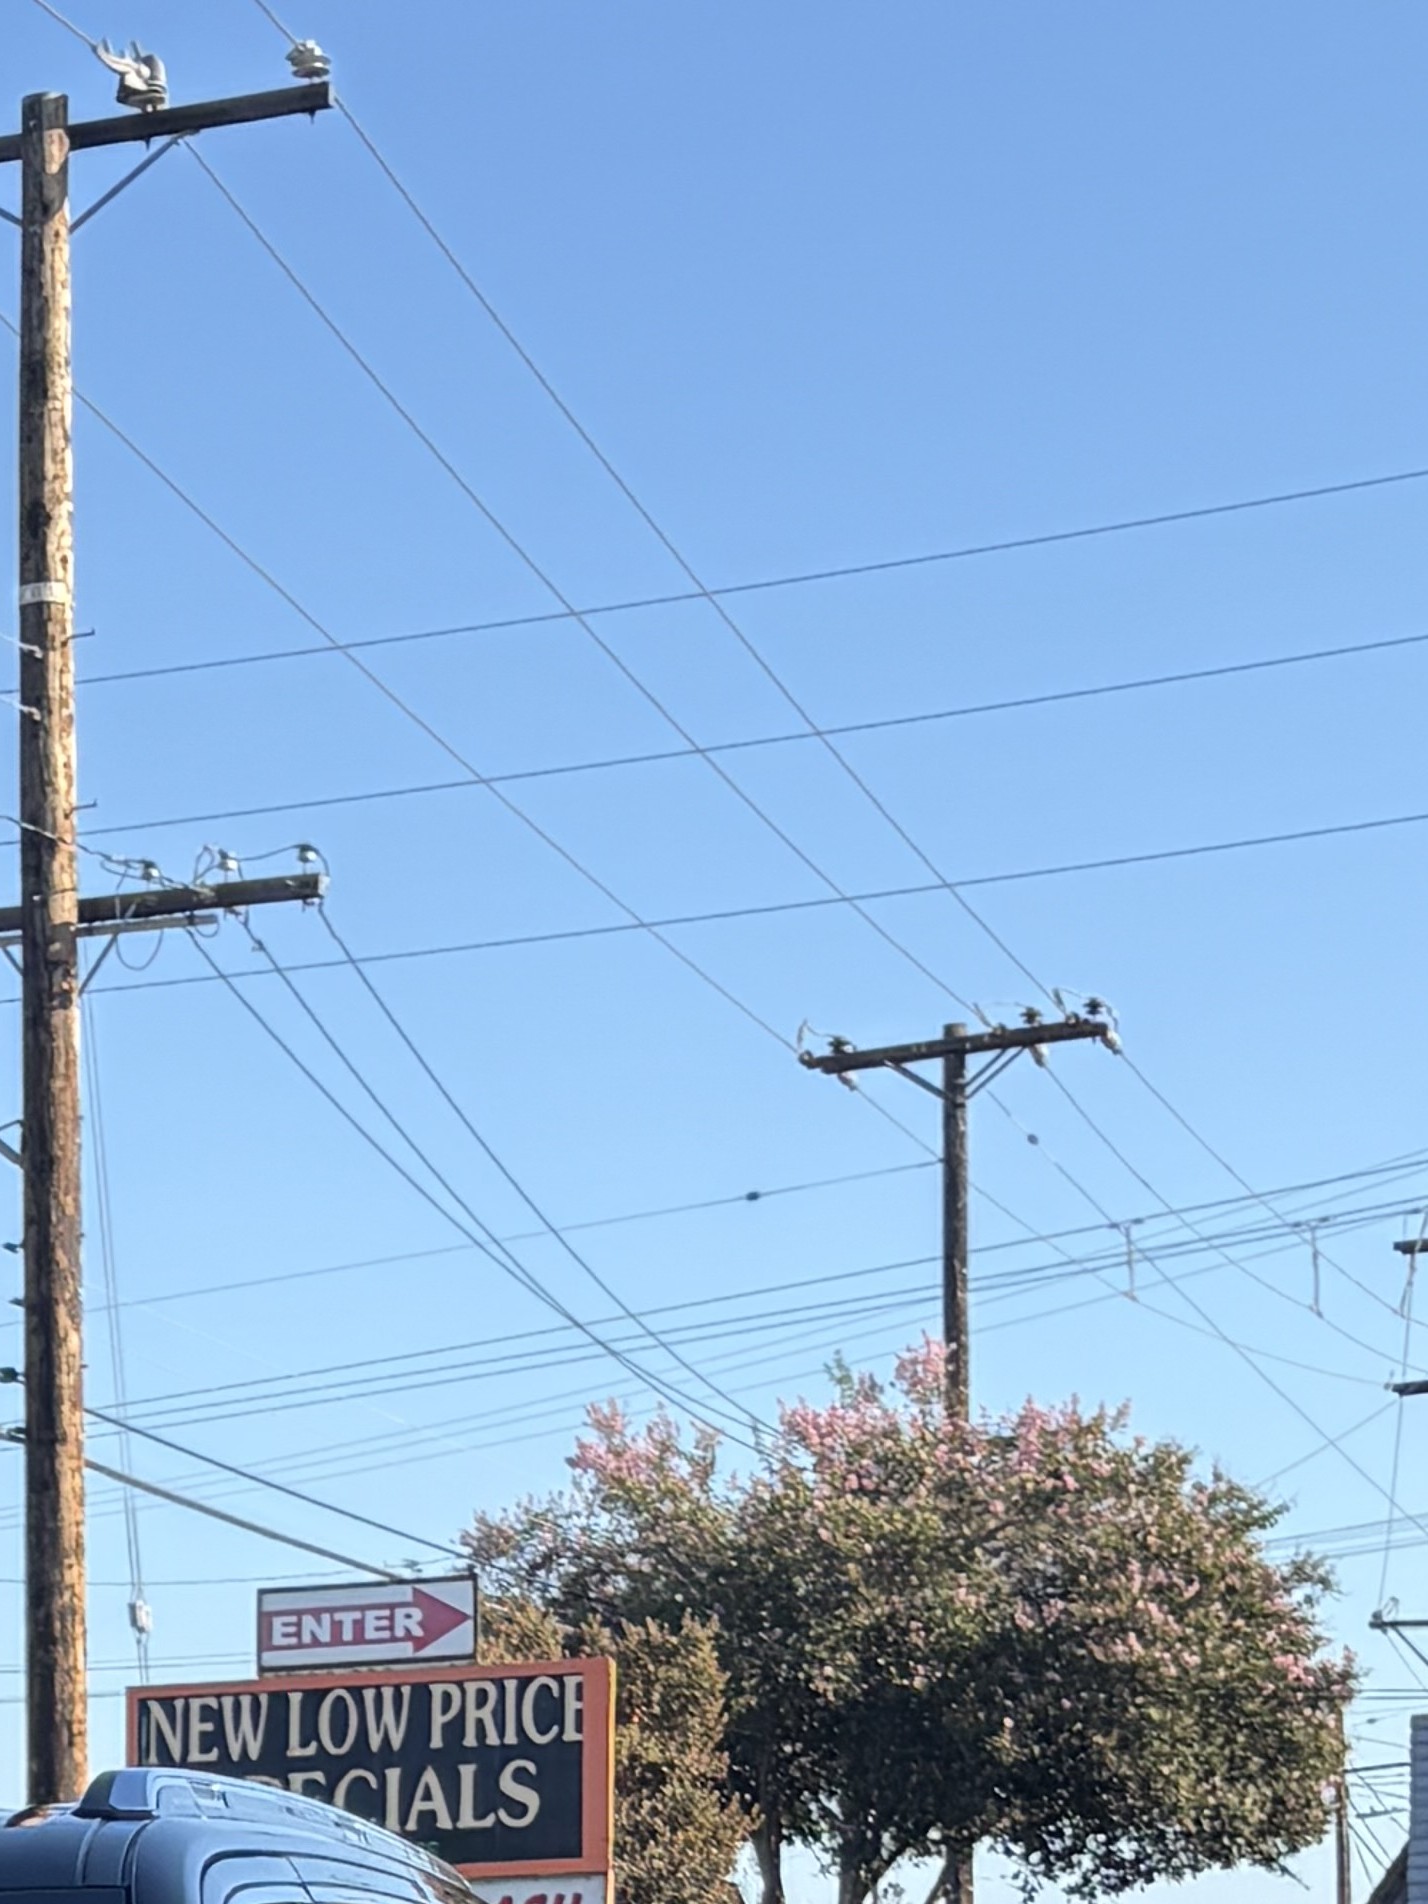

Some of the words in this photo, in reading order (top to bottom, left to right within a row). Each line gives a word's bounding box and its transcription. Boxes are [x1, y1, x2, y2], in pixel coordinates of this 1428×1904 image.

[271, 1607, 424, 1647] ENTER
[148, 1692, 268, 1765] NEW
[286, 1684, 412, 1757] LOW
[429, 1675, 583, 1749] PRICE
